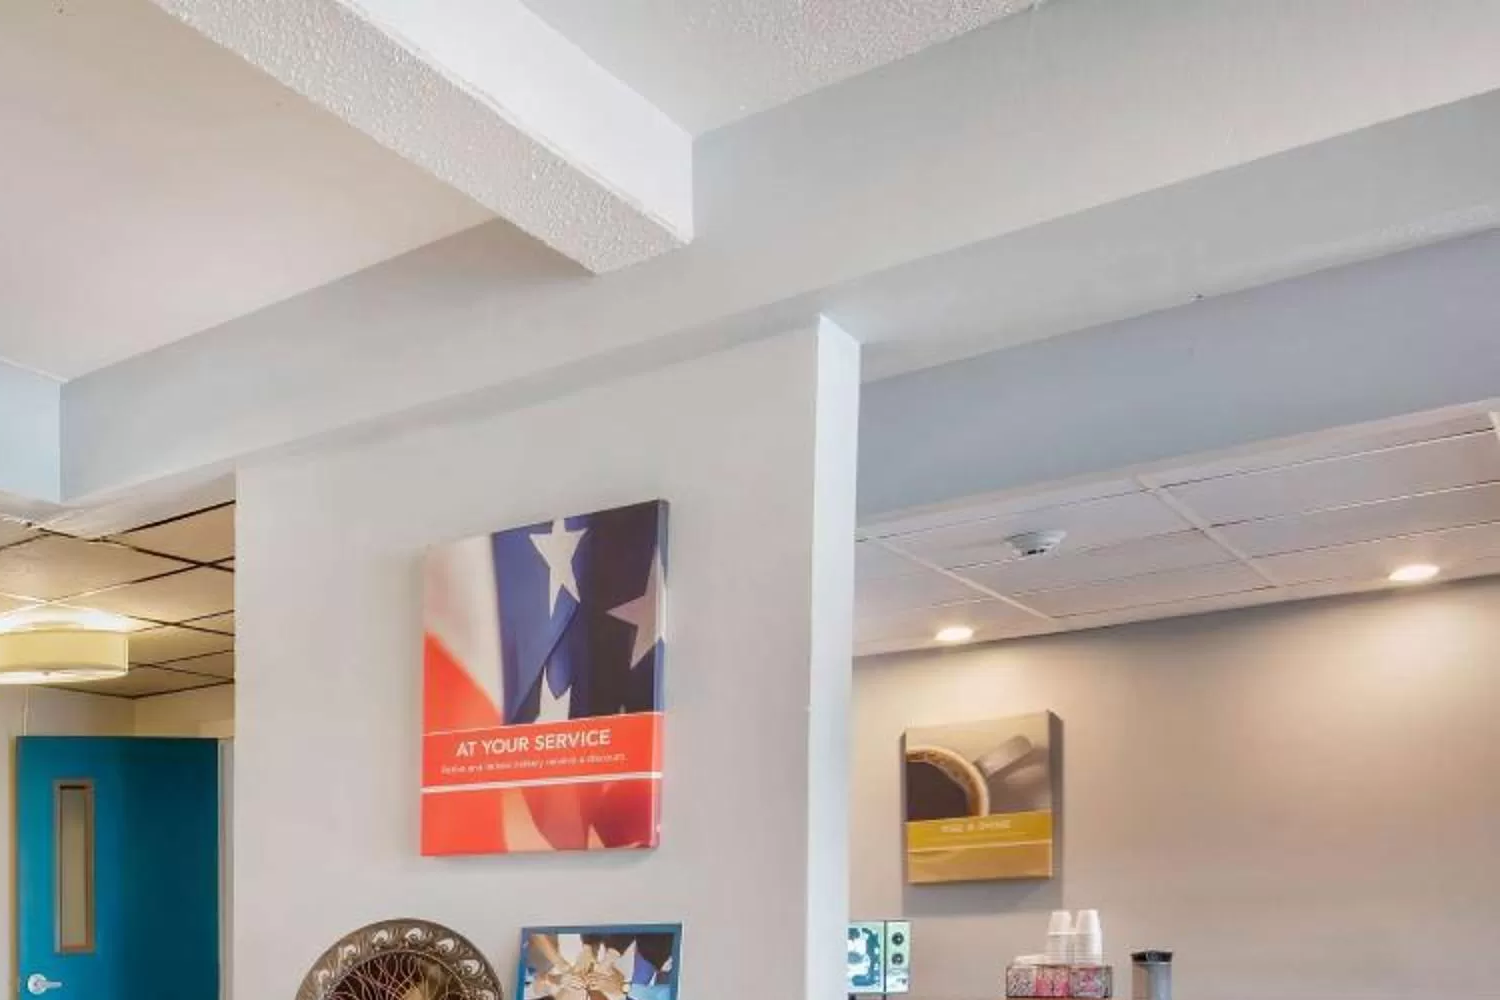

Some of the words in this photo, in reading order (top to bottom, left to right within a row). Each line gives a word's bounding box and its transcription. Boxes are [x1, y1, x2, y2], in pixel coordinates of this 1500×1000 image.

[456, 740, 477, 757] AT
[482, 736, 529, 755] YOUR
[535, 729, 611, 751] SERVICE
